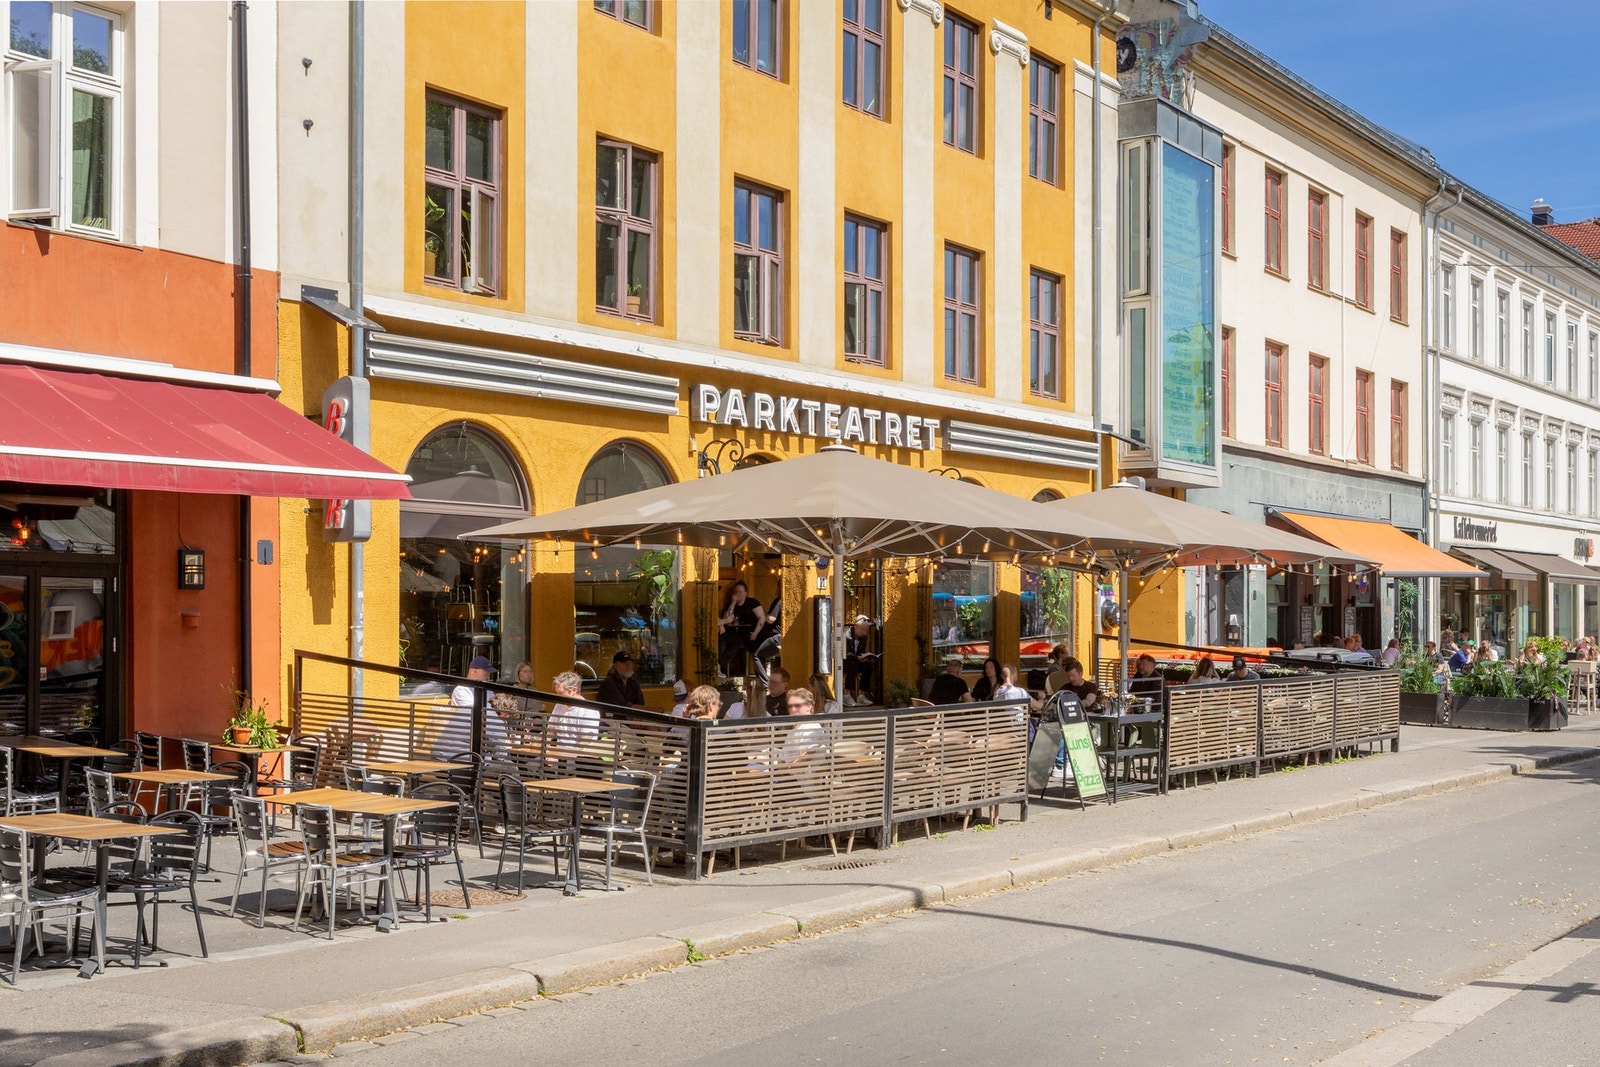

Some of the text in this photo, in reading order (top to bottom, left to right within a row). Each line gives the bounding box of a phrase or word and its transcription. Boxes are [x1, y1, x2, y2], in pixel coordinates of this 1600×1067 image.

[694, 383, 940, 450] PARKTEATRET
[325, 398, 349, 529] BR
[1067, 735, 1092, 751] Lunsj
[1073, 759, 1081, 773] &
[1076, 773, 1101, 787] Pizza
